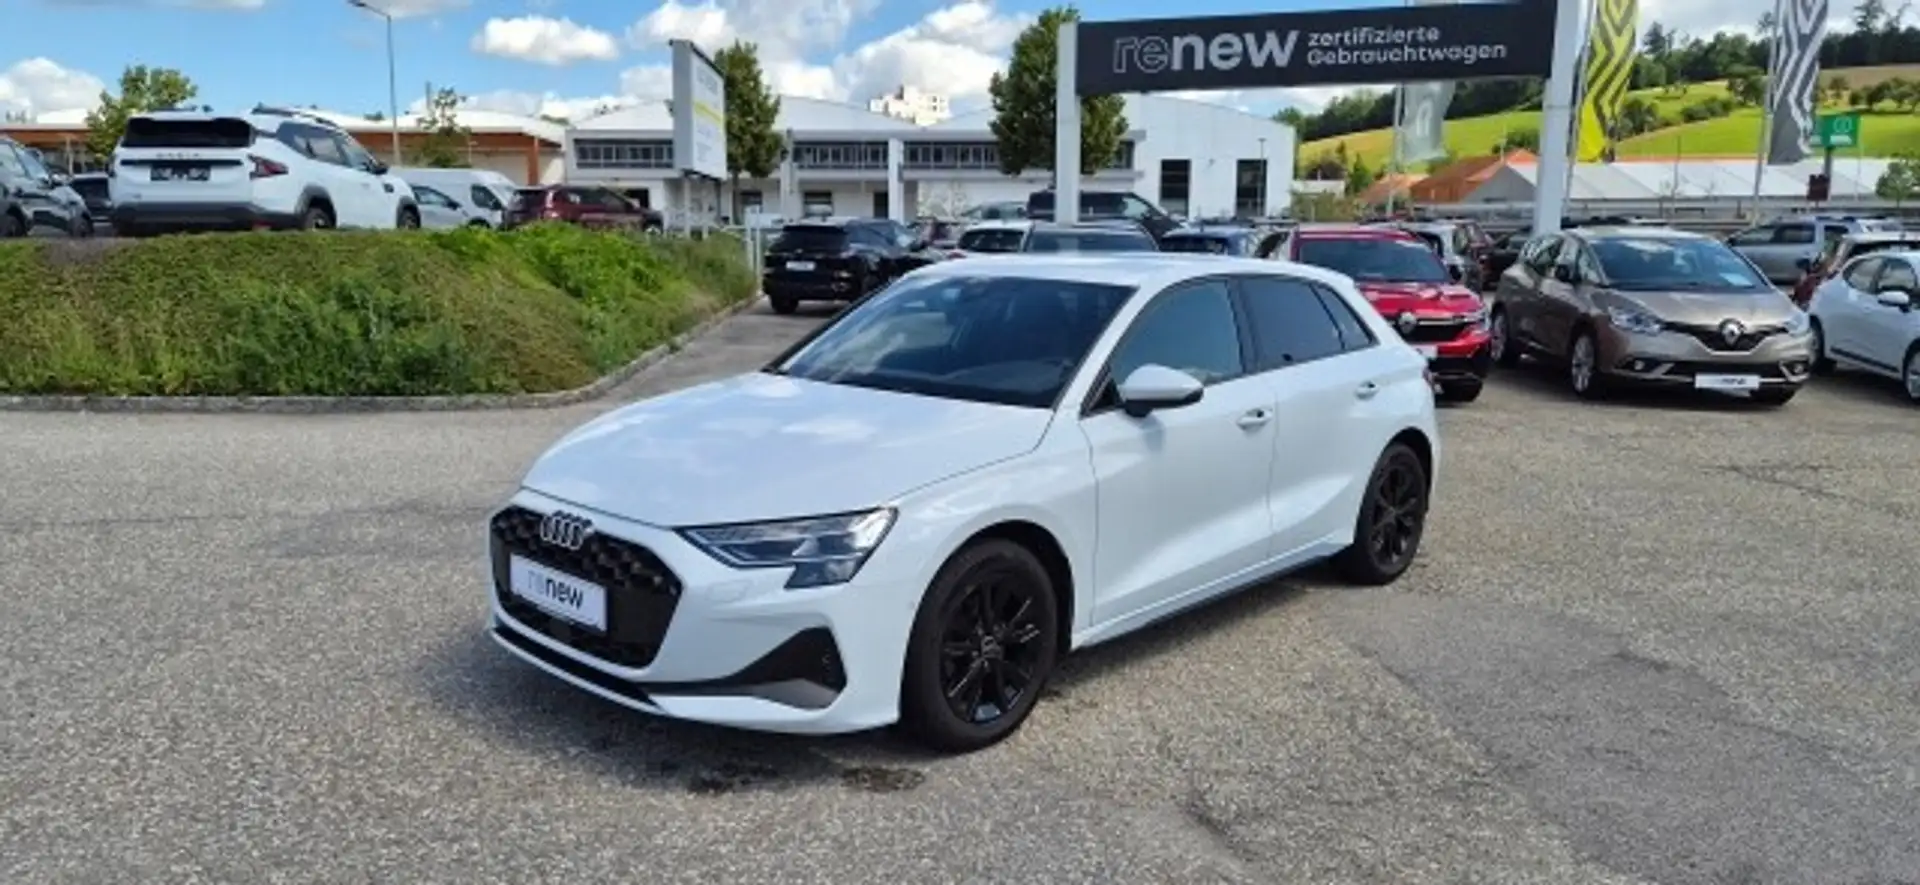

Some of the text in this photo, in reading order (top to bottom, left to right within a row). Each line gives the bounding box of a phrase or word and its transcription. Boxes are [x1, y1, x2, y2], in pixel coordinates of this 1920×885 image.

[1308, 26, 1440, 47] zertifizierte
[1113, 30, 1300, 74] renew
[1307, 44, 1507, 66] Gebrauchtwagen
